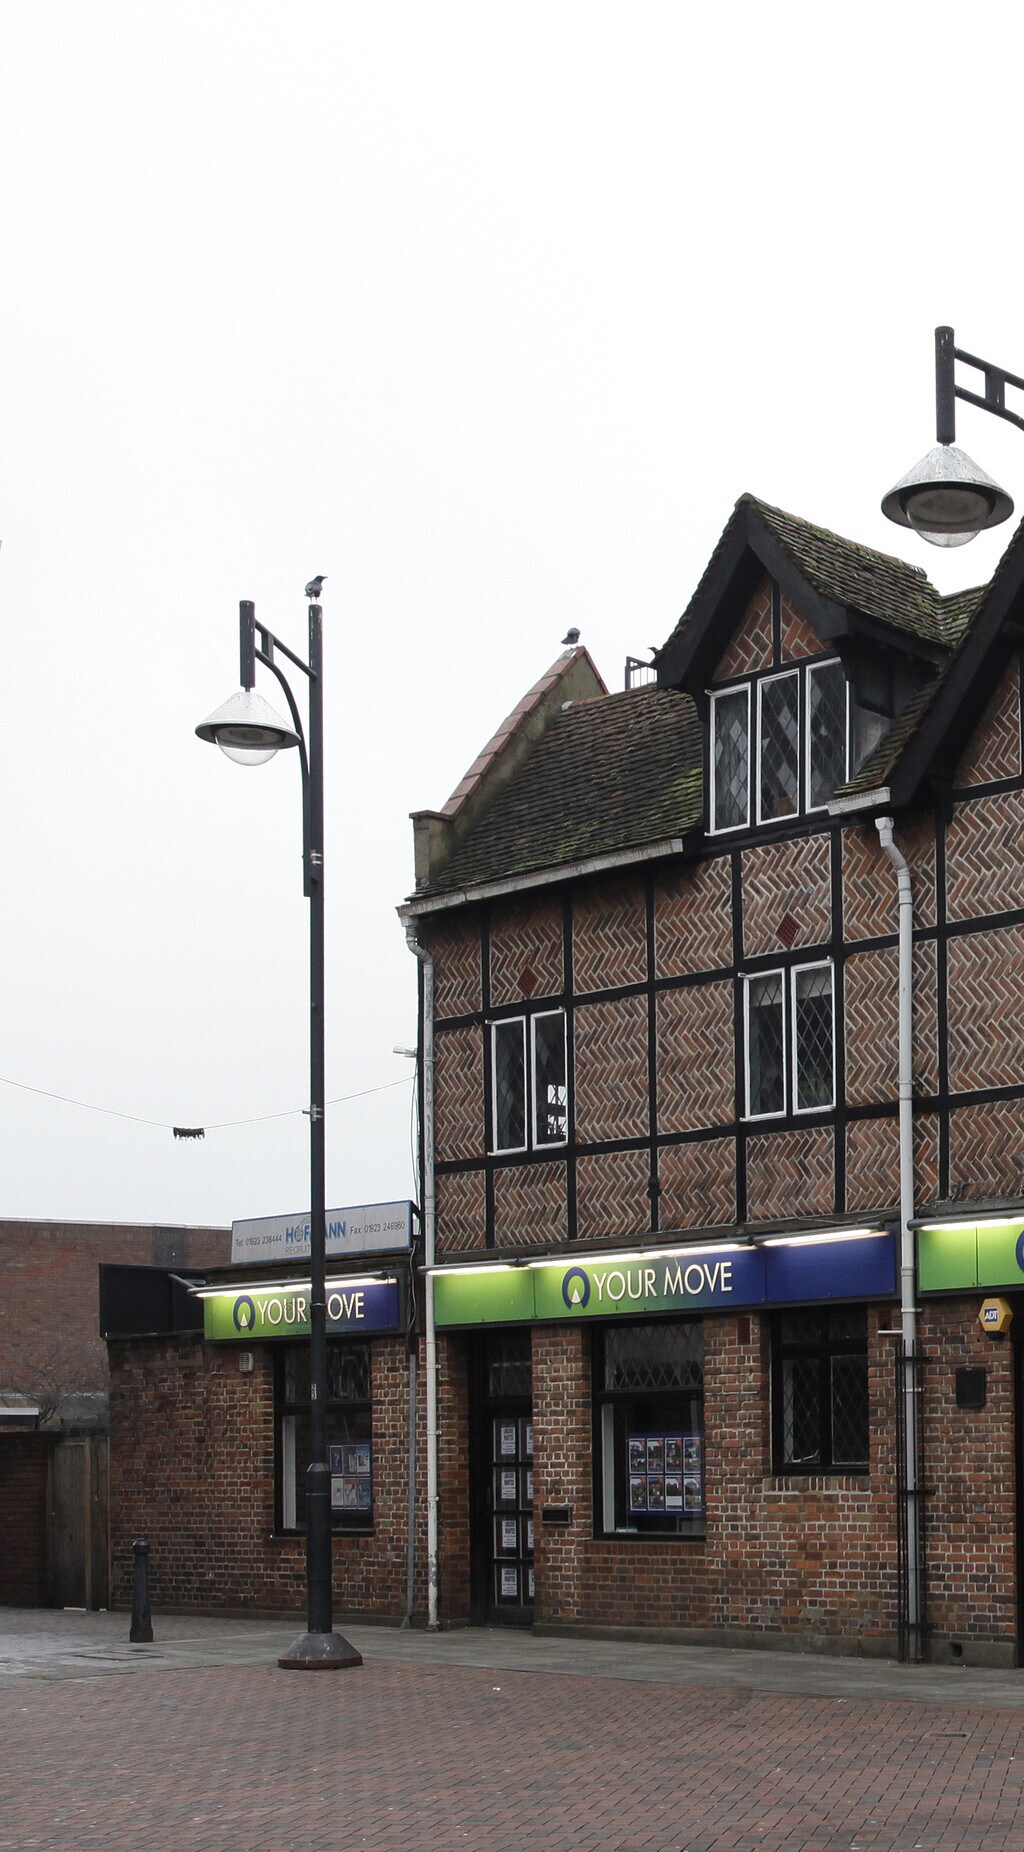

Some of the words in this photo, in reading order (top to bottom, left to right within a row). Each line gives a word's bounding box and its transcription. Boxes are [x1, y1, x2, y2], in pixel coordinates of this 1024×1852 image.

[245, 1236, 261, 1247] 01923
[285, 1221, 346, 1244] HOFNN
[364, 1223, 381, 1234] 01923
[285, 1245, 311, 1255] RECRUIT
[593, 1269, 658, 1301] YOUR
[663, 1261, 733, 1295] MOVE
[257, 1297, 308, 1326] YOUR
[325, 1292, 365, 1321] OVE
[984, 1310, 998, 1320] ADT
